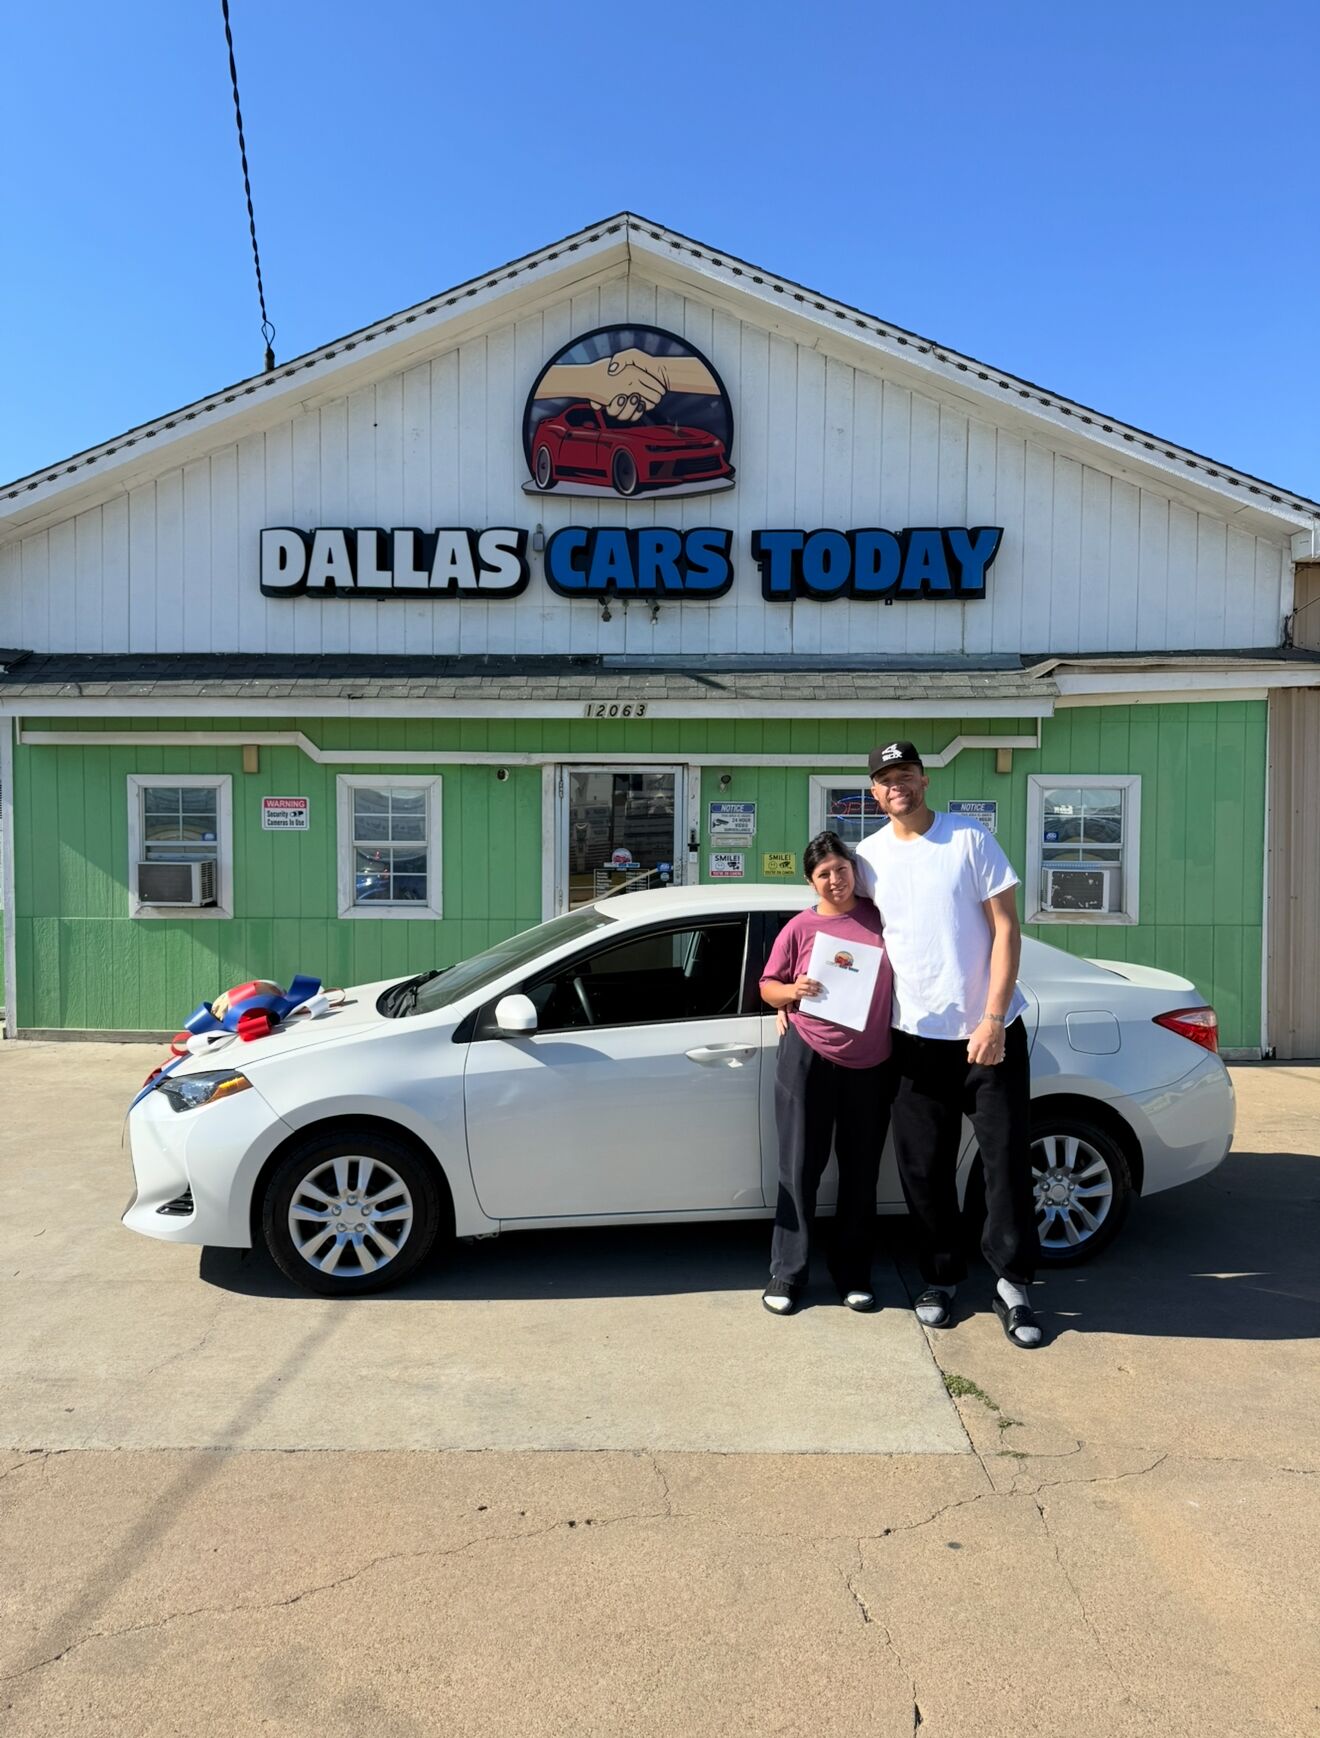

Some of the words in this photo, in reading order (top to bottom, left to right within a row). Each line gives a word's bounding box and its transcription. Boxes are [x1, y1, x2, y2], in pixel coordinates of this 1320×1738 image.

[261, 528, 522, 590] DALLAS
[549, 528, 730, 590] CARS
[759, 528, 1001, 592] TODAY
[587, 704, 646, 717] 12063
[266, 800, 306, 808] WARNING
[720, 804, 745, 813] NOTICE
[961, 803, 985, 812] NOTICE
[267, 810, 289, 819] Security
[267, 818, 289, 826] Cameras
[295, 818, 305, 826] Use
[715, 854, 740, 862] SMILE!
